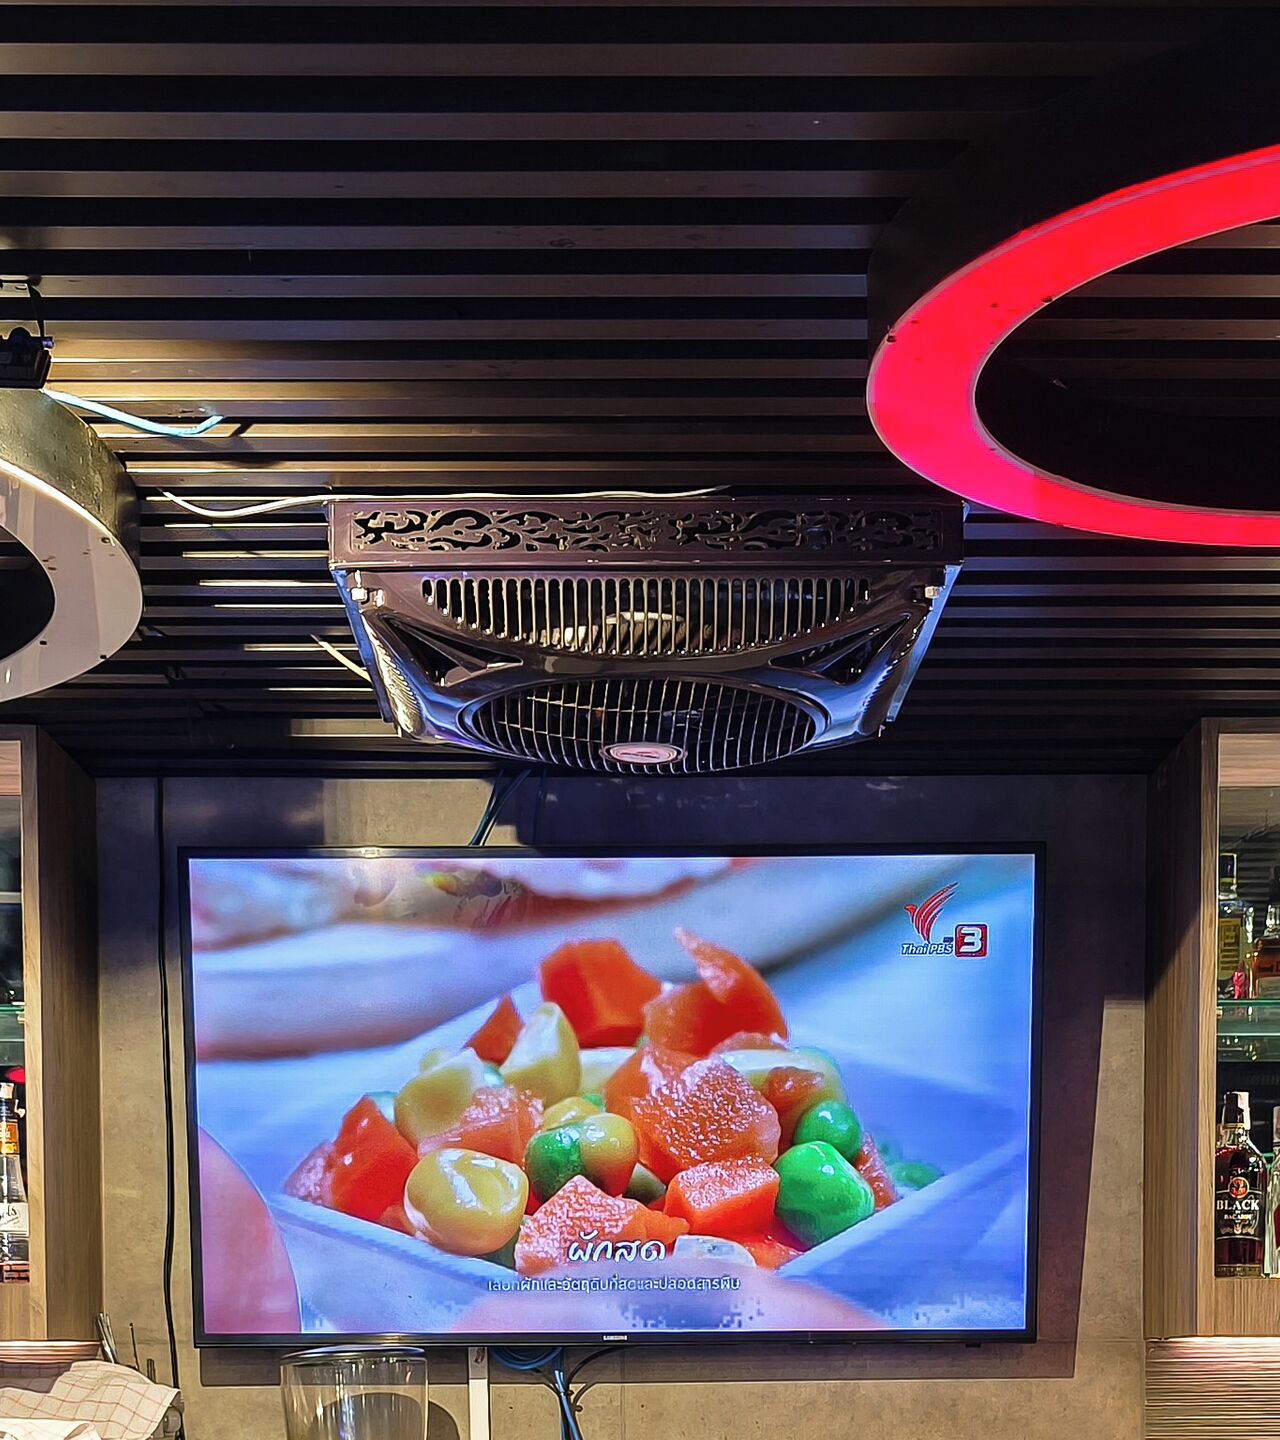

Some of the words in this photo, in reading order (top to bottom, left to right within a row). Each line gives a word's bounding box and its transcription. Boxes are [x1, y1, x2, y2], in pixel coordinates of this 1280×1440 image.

[902, 943, 928, 955] Thai
[929, 943, 953, 955] PBS
[959, 926, 983, 953] 3
[1216, 1200, 1260, 1210] BLACK
[568, 1230, 666, 1263] ผักสด
